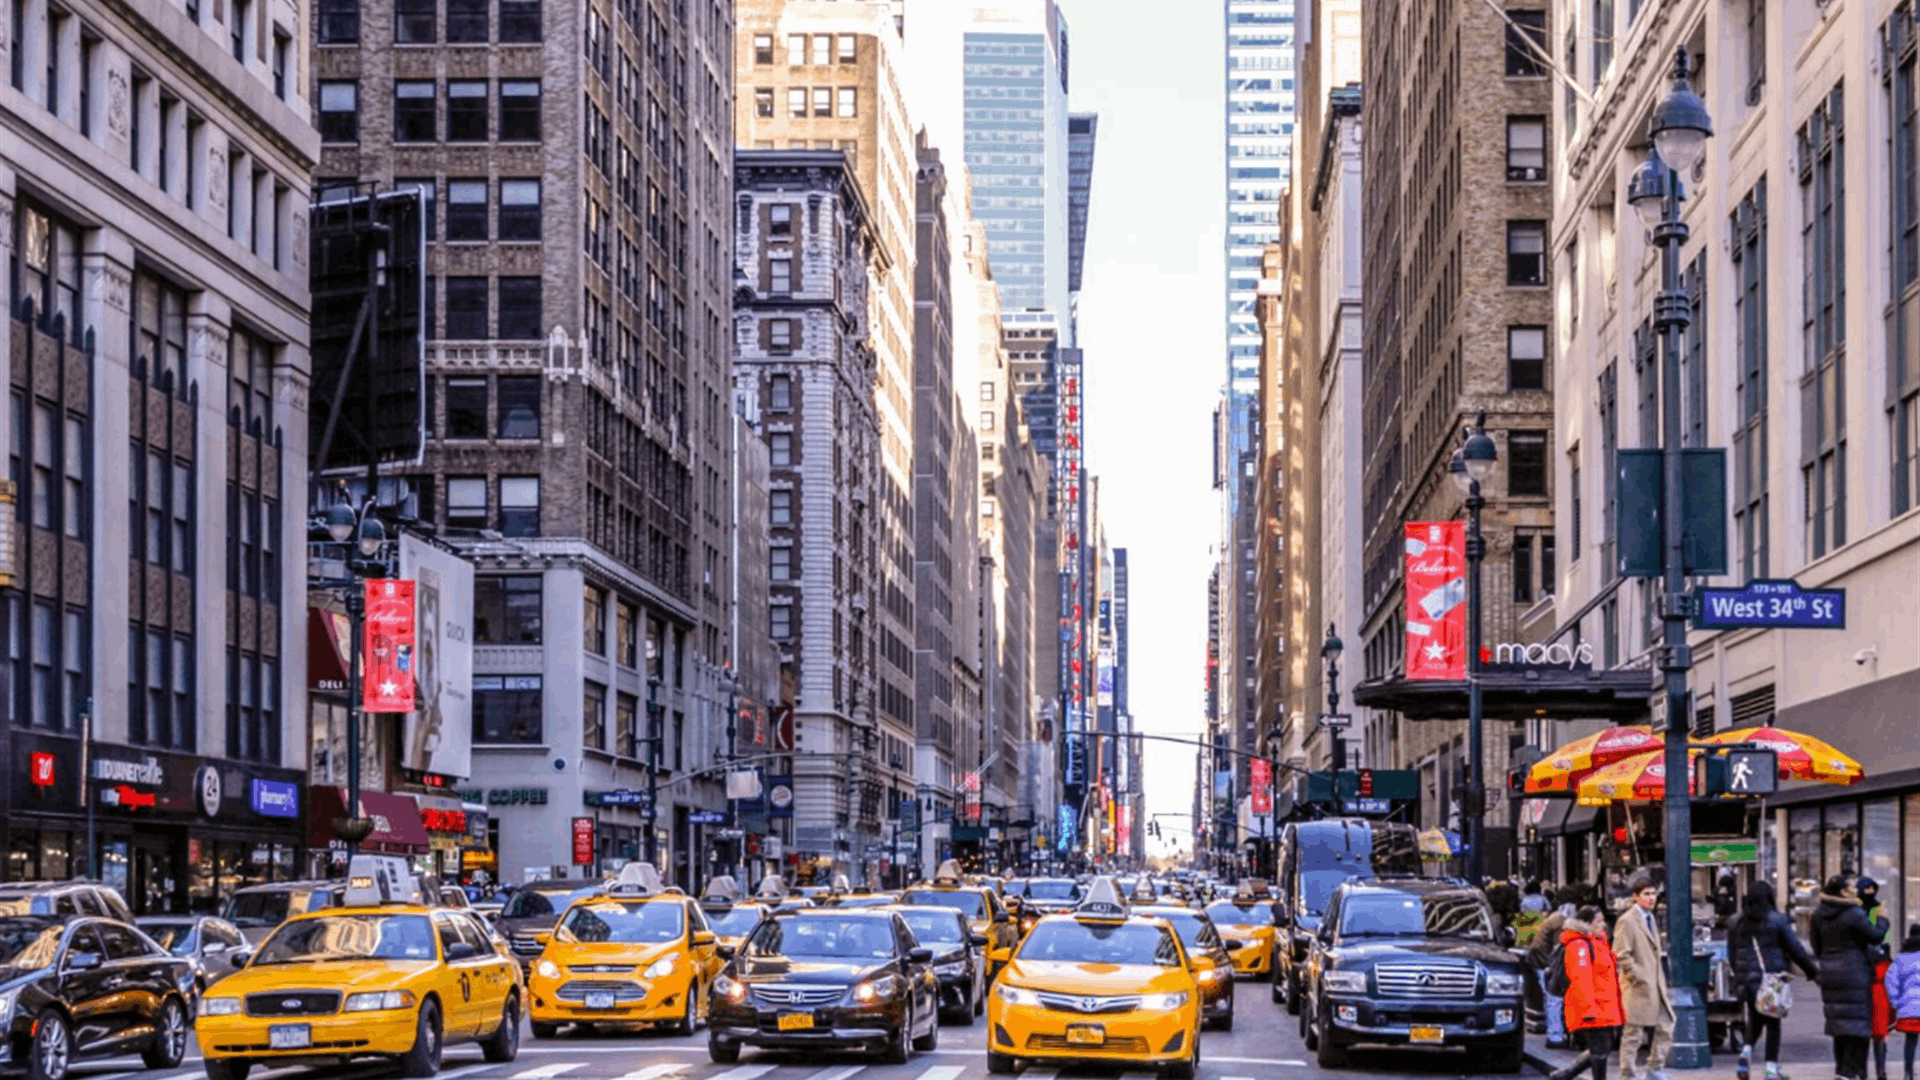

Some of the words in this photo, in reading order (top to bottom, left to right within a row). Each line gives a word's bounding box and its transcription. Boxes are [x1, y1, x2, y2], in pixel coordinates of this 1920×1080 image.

[1712, 597, 1765, 618] West
[1768, 596, 1807, 618] 34th
[1812, 598, 1834, 619] St
[318, 679, 343, 689] DELI
[206, 773, 218, 798] 24
[488, 788, 548, 805] COFFEE
